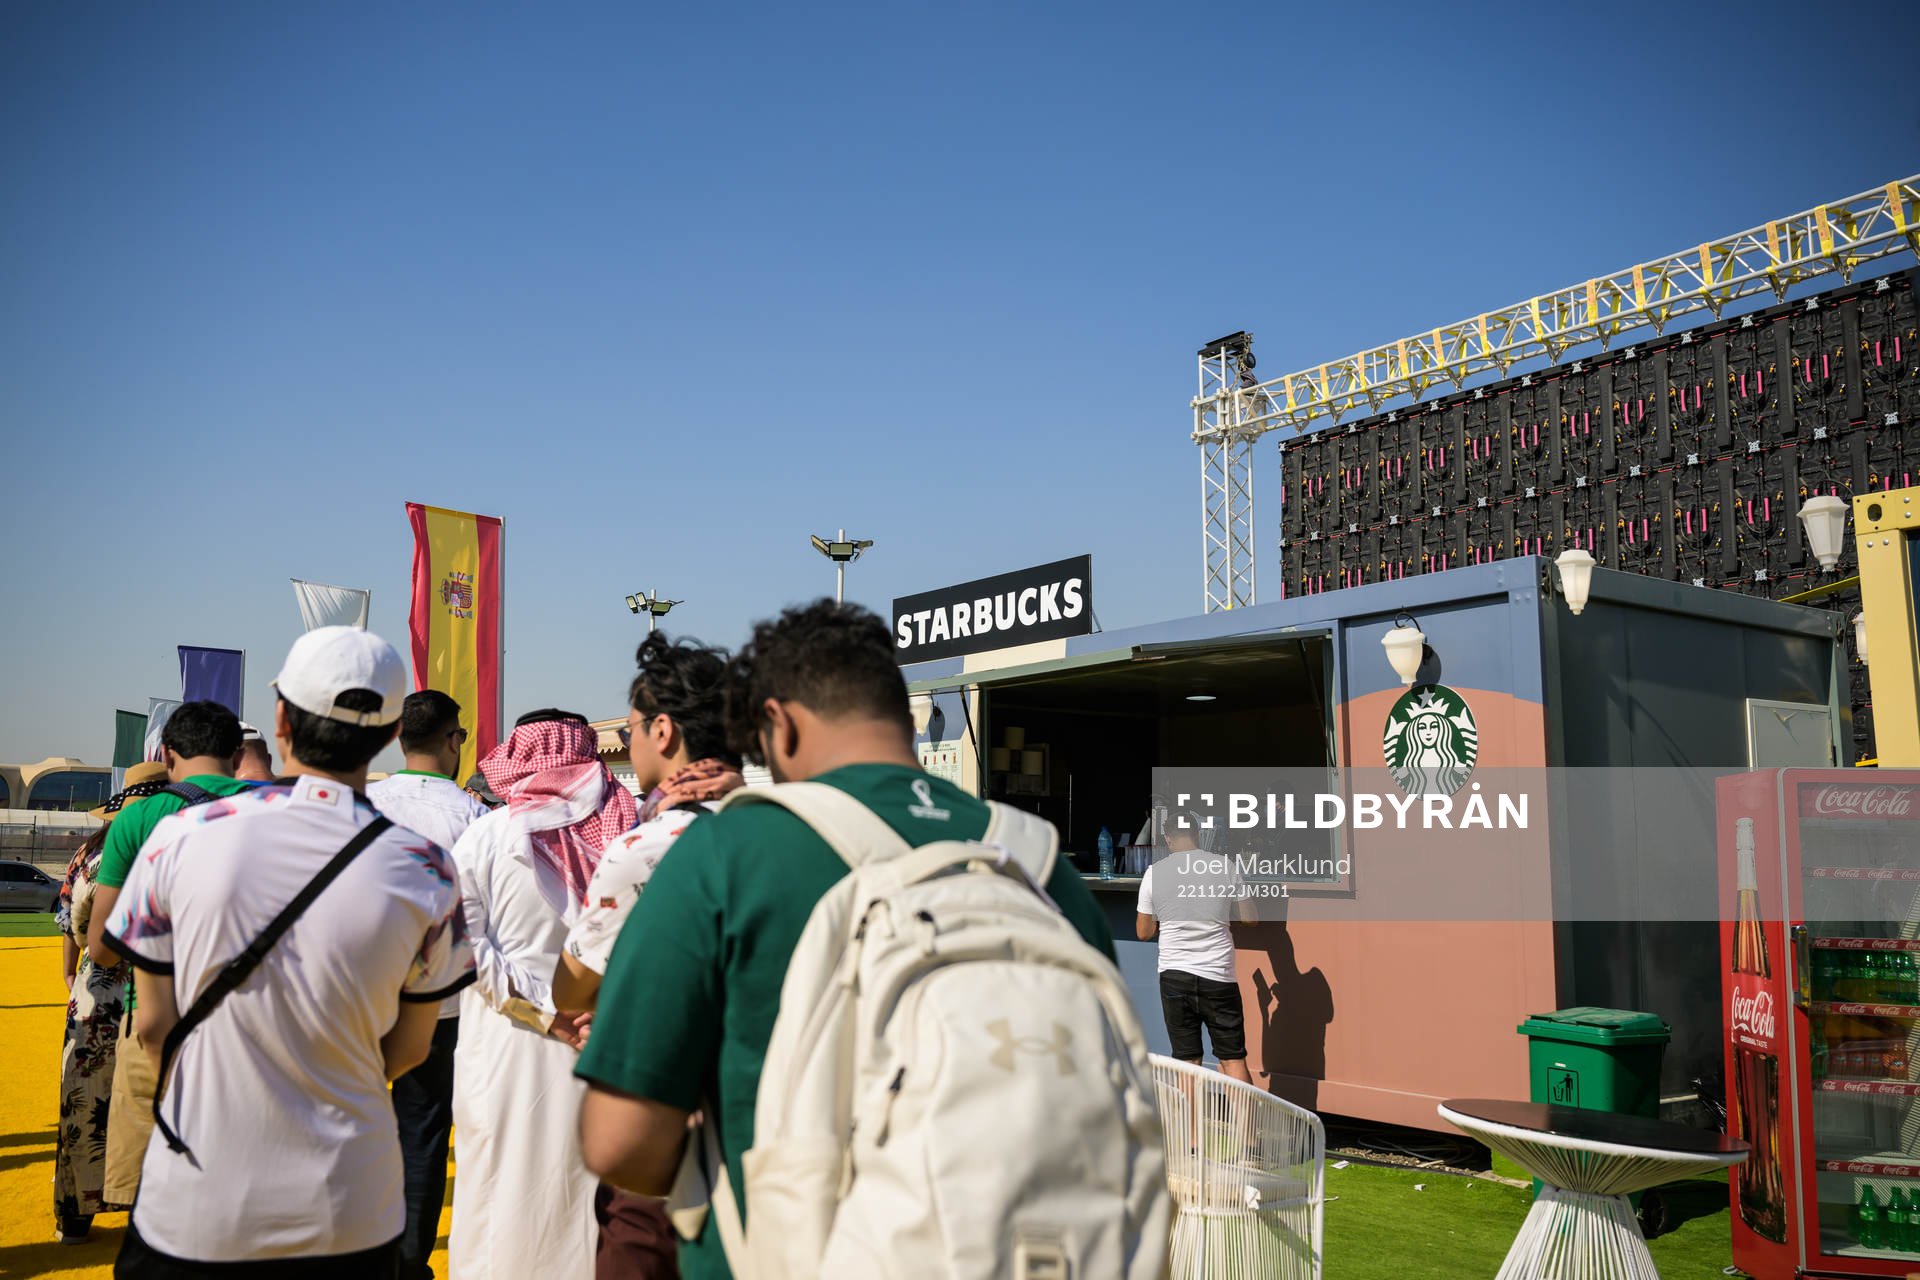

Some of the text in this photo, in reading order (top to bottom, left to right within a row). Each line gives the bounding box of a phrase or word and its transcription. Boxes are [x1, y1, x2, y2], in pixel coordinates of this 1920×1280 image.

[897, 578, 1083, 648] STARBUCKS
[1815, 785, 1912, 815] Coca-Cola
[1732, 986, 1775, 1038] Coca-Cola
